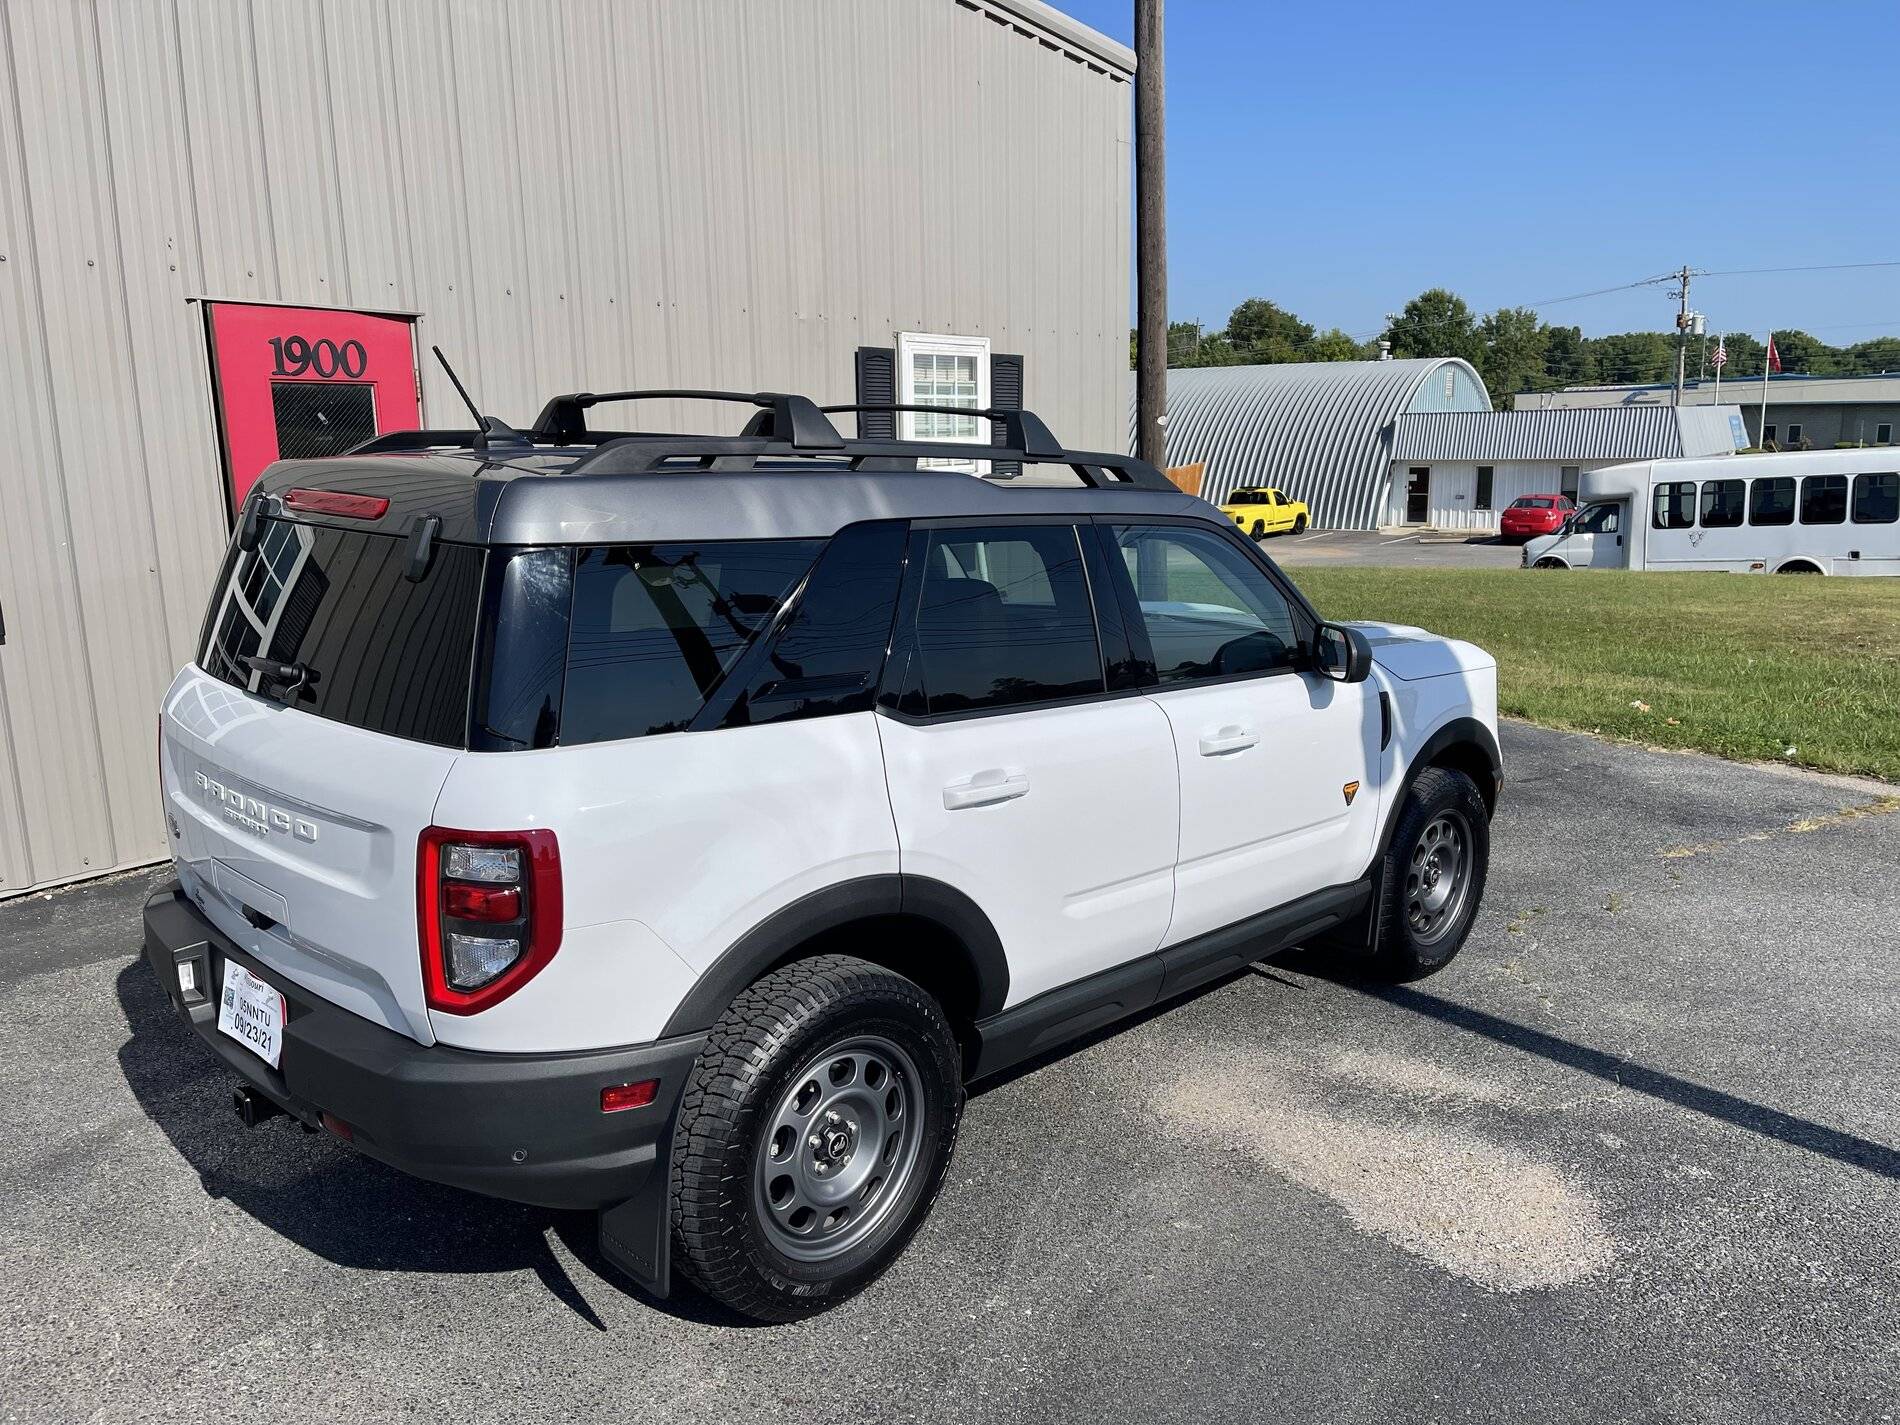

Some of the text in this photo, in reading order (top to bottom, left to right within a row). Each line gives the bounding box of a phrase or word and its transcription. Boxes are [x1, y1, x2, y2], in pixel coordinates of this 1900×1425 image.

[268, 335, 368, 378] 1900
[194, 770, 317, 841] BRONCO
[224, 806, 269, 835] SPORT
[234, 1012, 272, 1053] 09/23/21
